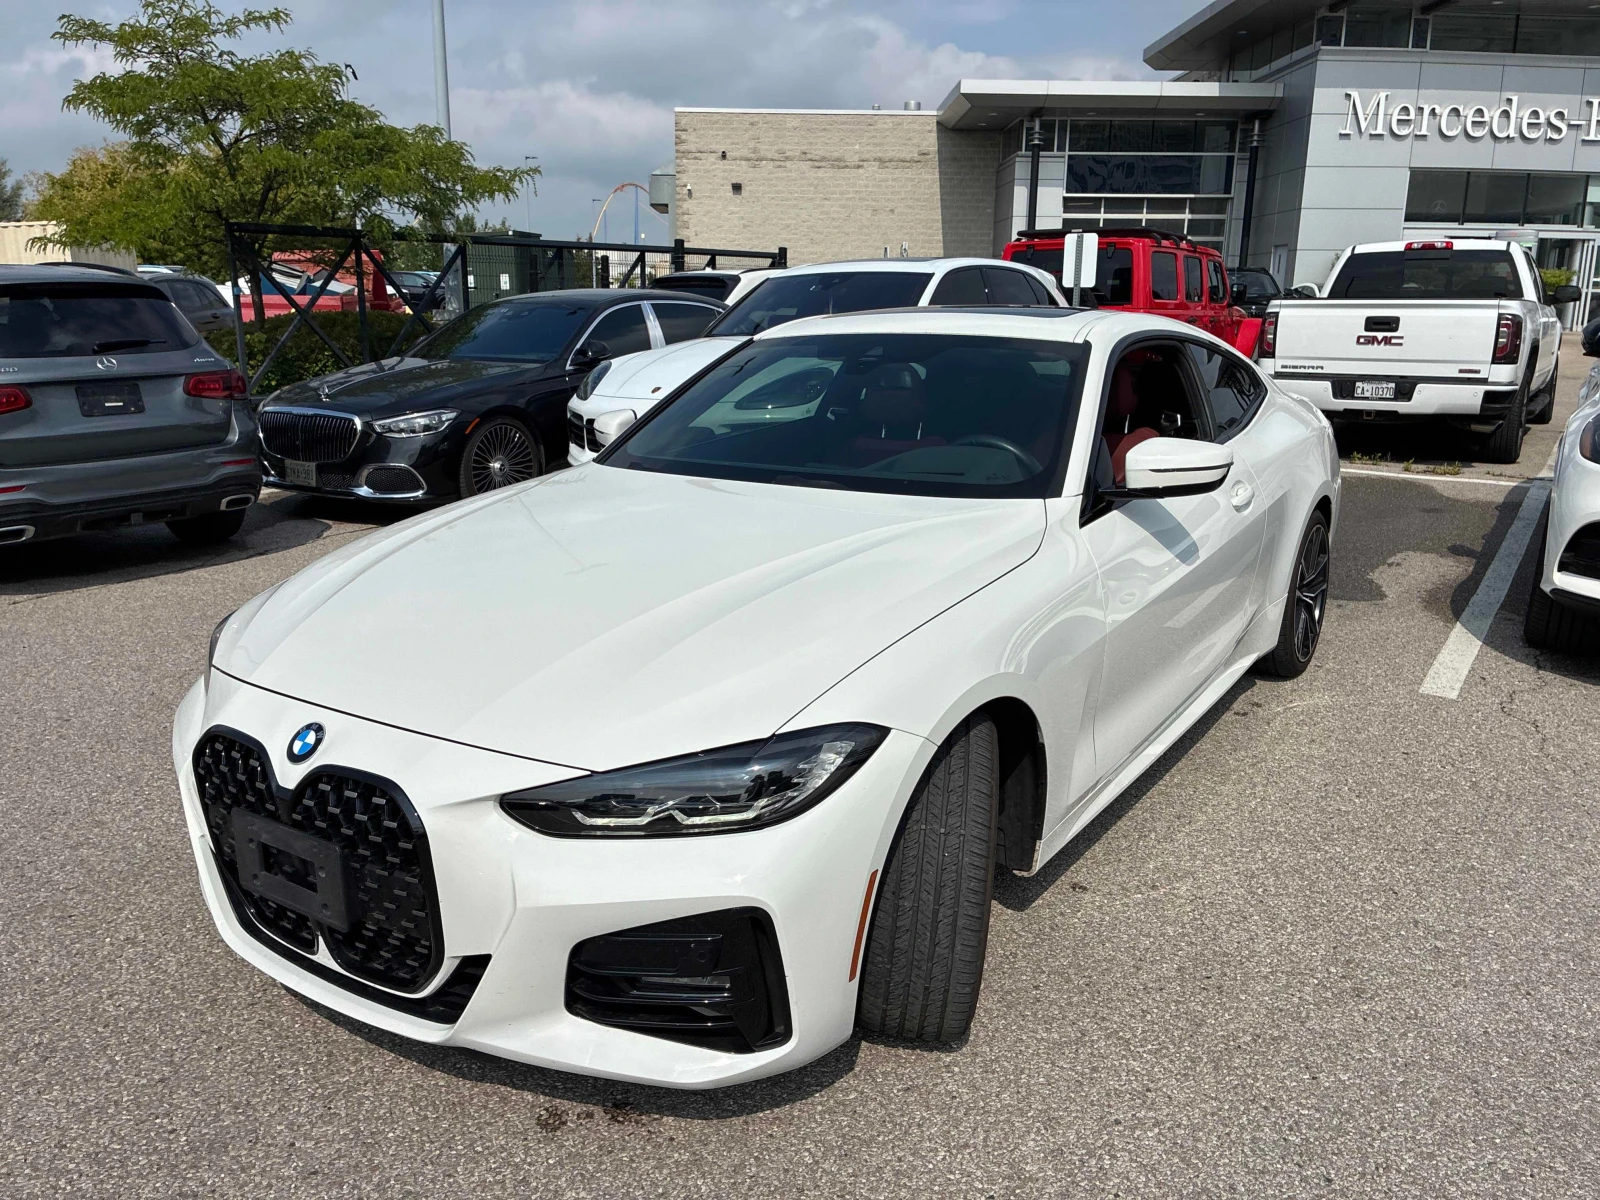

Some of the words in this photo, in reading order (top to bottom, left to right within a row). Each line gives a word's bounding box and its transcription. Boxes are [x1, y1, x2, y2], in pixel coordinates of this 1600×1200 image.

[1356, 335, 1404, 346] GMC
[1355, 386, 1365, 396] CA
[1370, 386, 1394, 397] 10370
[299, 724, 324, 739] BMW
